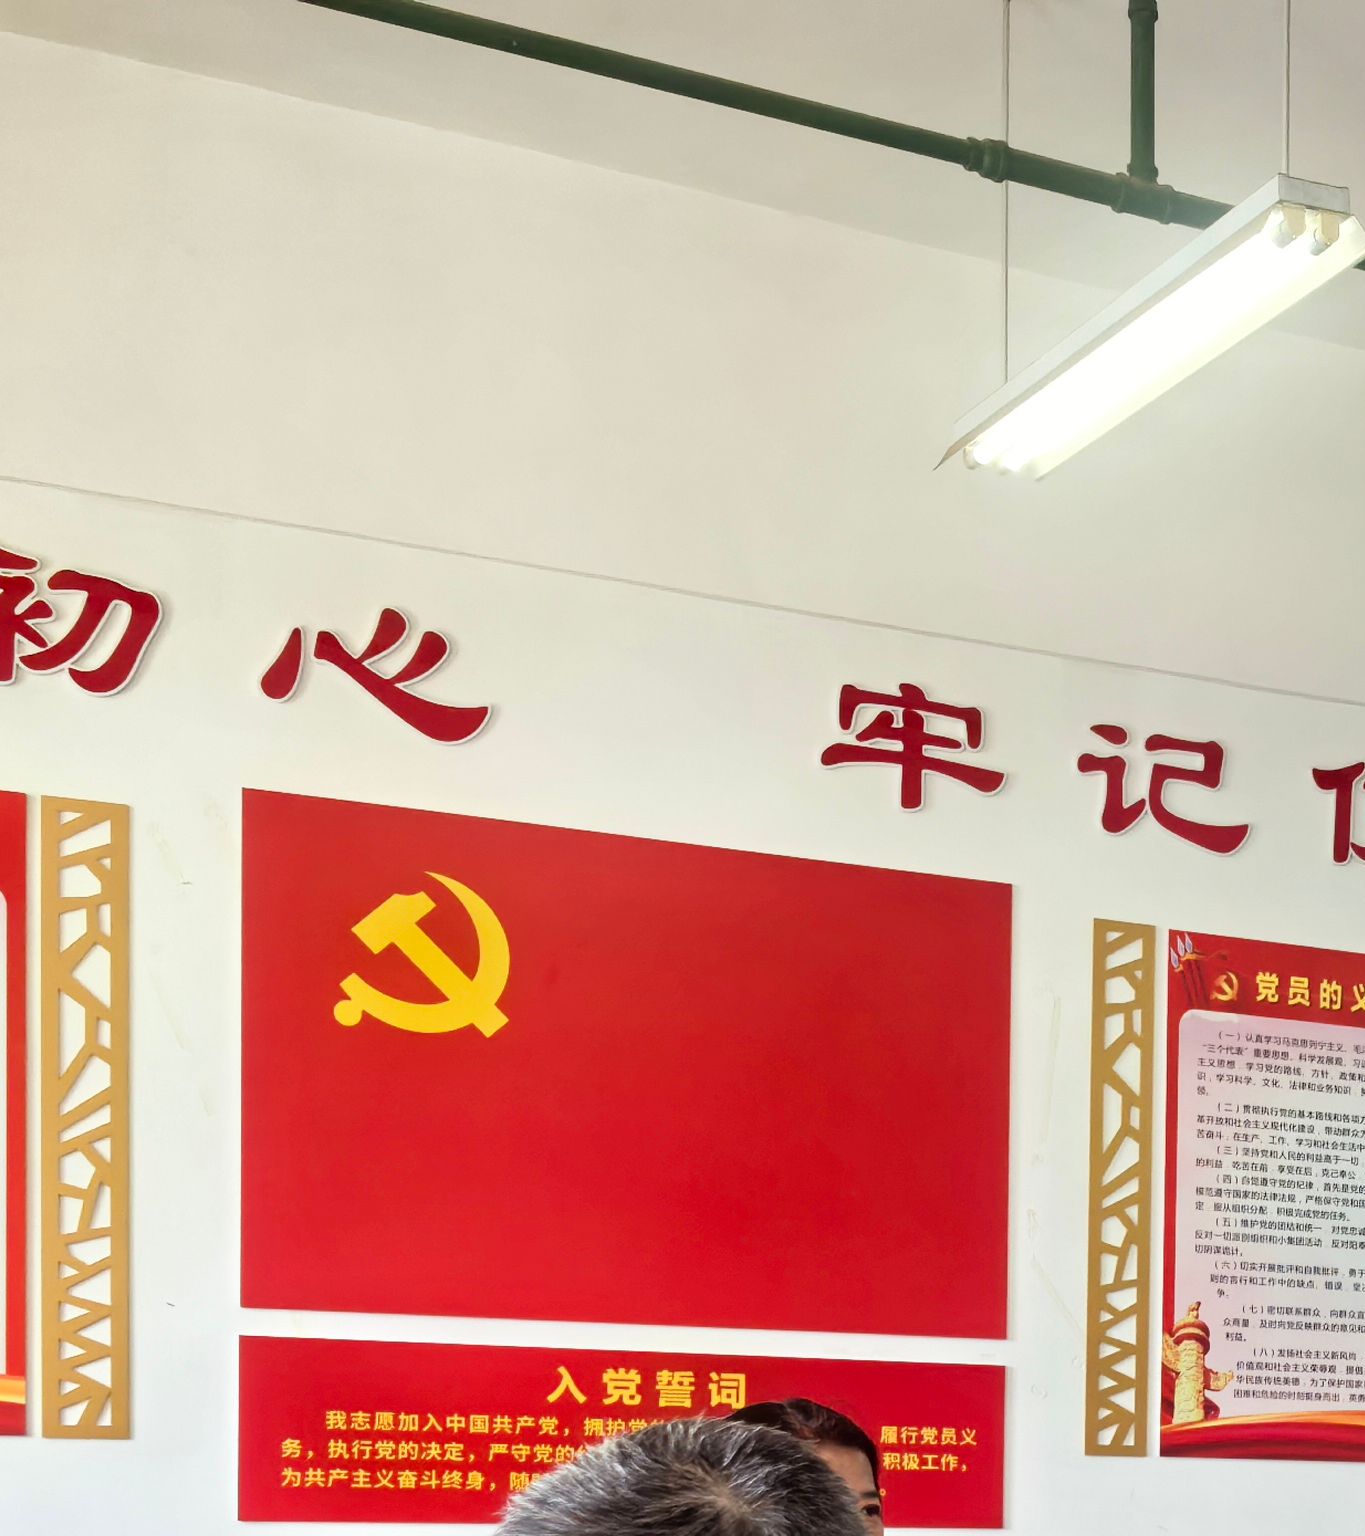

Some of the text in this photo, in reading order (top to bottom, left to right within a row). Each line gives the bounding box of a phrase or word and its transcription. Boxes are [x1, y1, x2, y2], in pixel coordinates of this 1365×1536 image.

[546, 1365, 747, 1410] 入党誓词
[880, 1426, 977, 1446] 履行党员义
[281, 1438, 967, 1472] 务，执行党的决定，严守党的 积极工作，
[281, 1467, 545, 1492] 为共产主义奋斗终身，随
